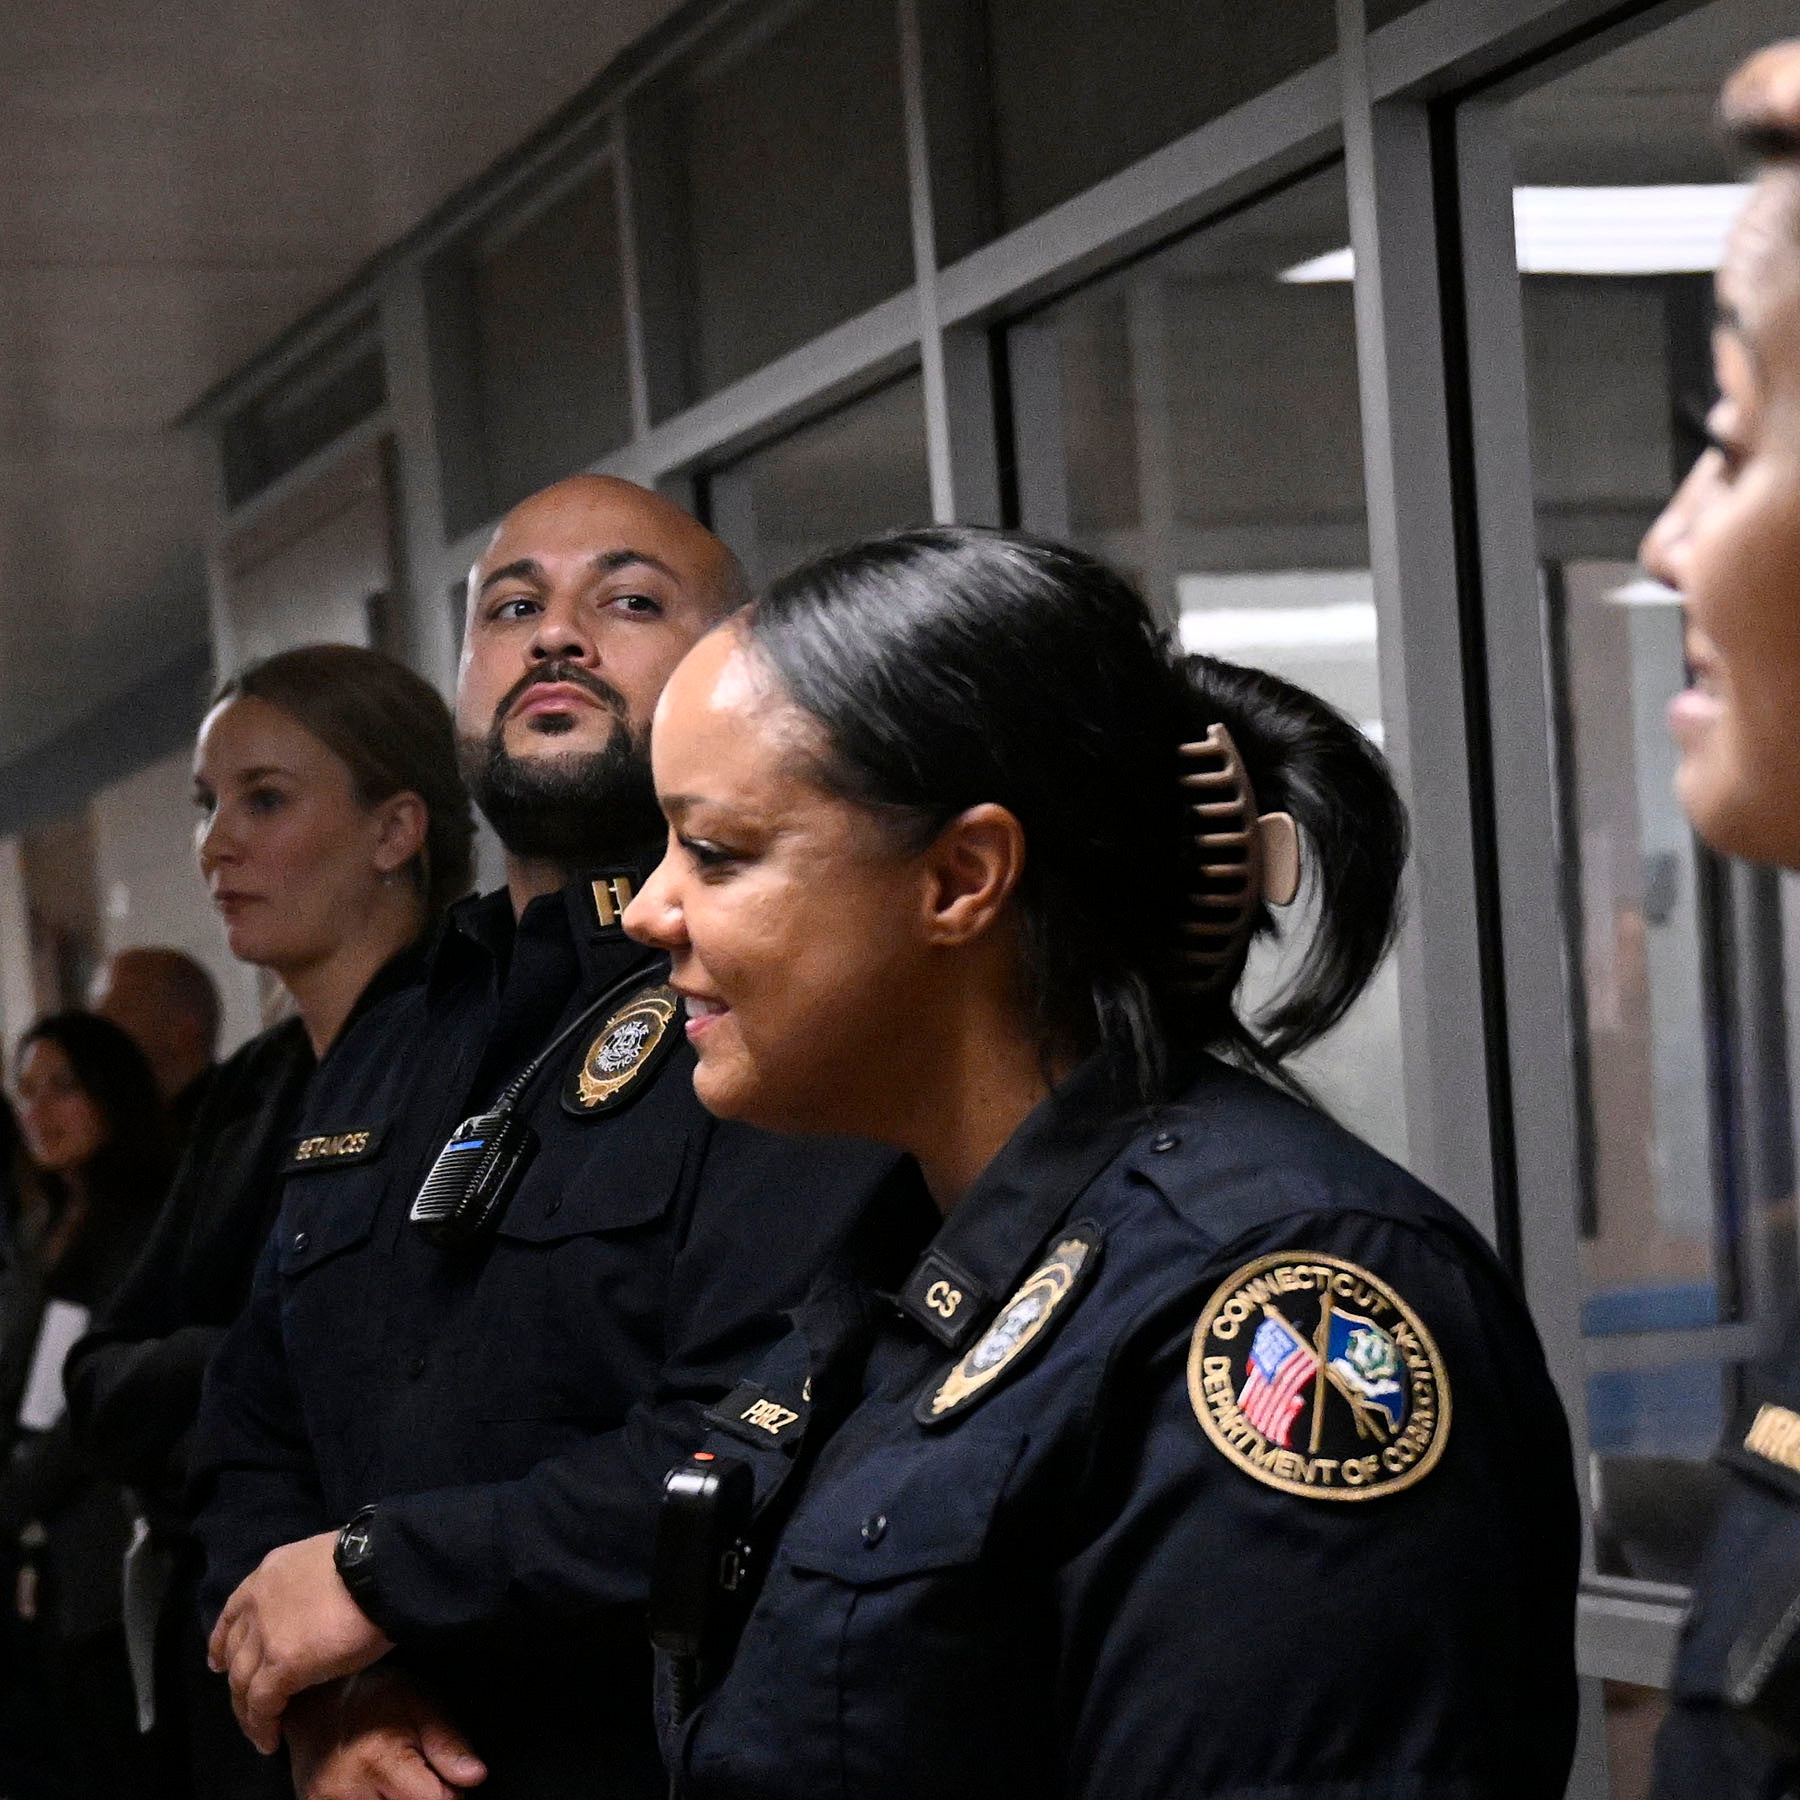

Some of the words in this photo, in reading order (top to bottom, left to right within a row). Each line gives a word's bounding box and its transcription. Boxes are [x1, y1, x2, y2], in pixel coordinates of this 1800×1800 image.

[926, 1280, 962, 1318] CS
[740, 1399, 799, 1434] PEREZ
[1203, 1356, 1340, 1483] DEPARTMENT
